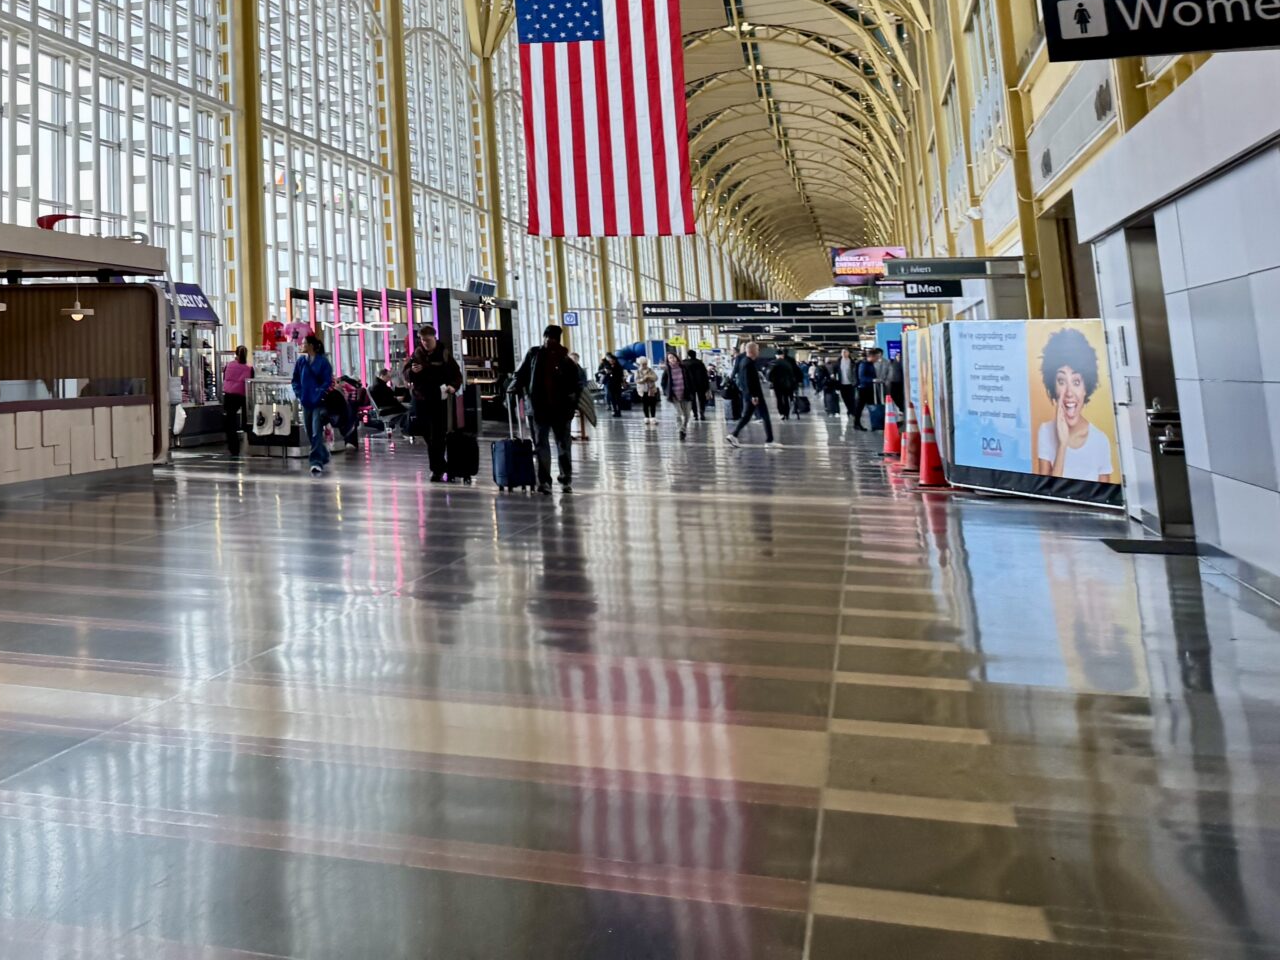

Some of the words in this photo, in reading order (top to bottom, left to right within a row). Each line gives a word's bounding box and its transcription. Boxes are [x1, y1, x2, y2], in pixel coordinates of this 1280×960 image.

[910, 266, 932, 274] Men
[918, 284, 942, 293] Men
[482, 296, 496, 305] MAC
[321, 321, 394, 331] MAC
[982, 437, 1002, 451] DCA
